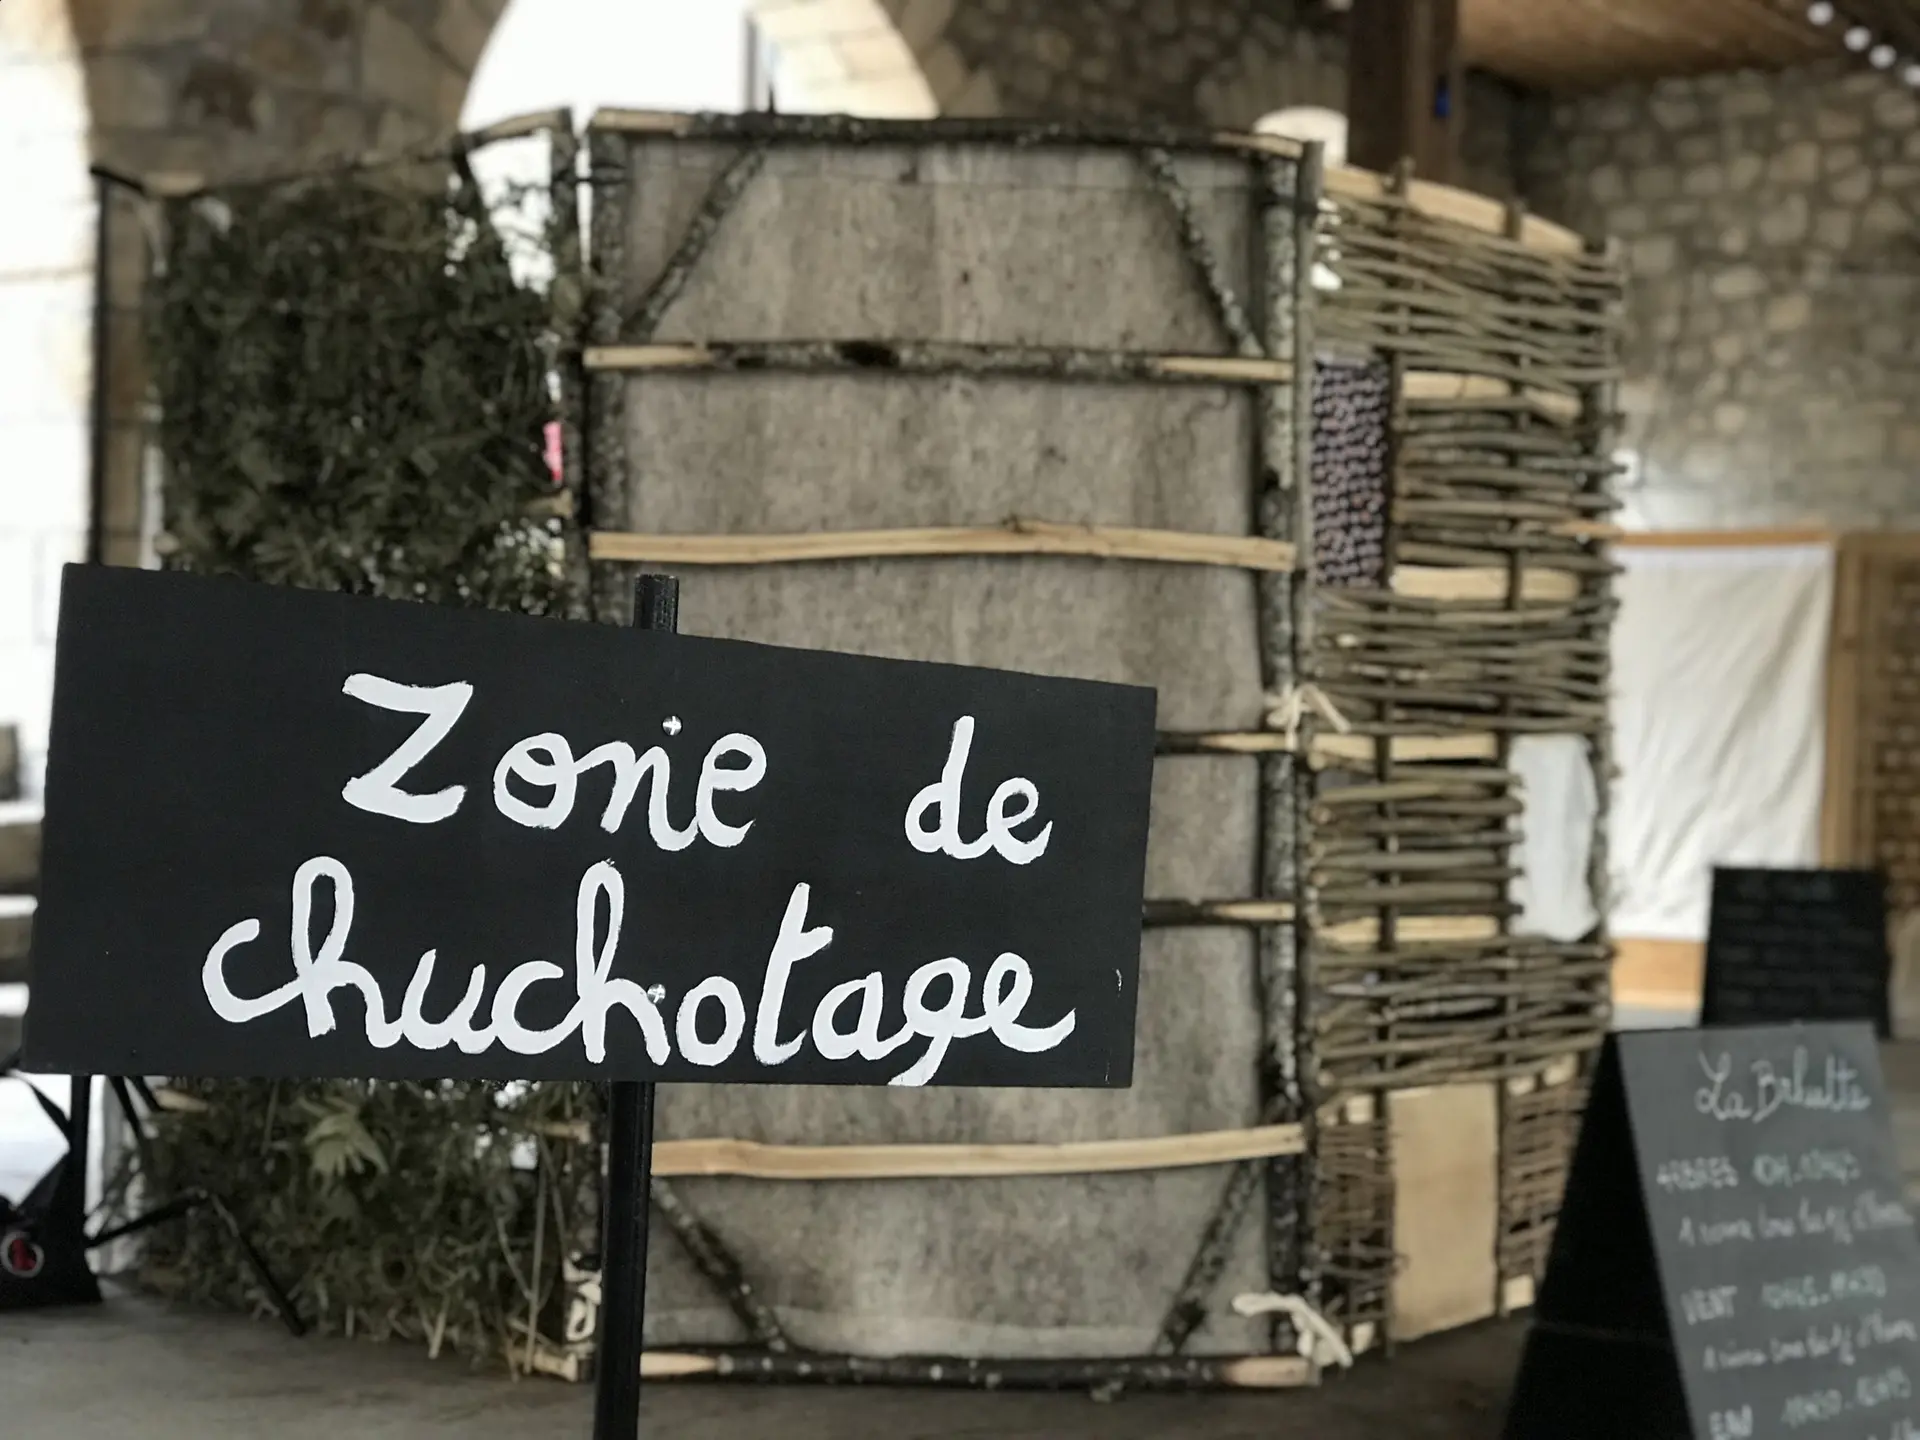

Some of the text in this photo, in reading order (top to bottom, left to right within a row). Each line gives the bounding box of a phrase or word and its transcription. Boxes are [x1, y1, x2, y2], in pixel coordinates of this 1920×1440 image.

[341, 673, 1053, 865] Zone de
[202, 856, 1076, 1088] chuchotage
